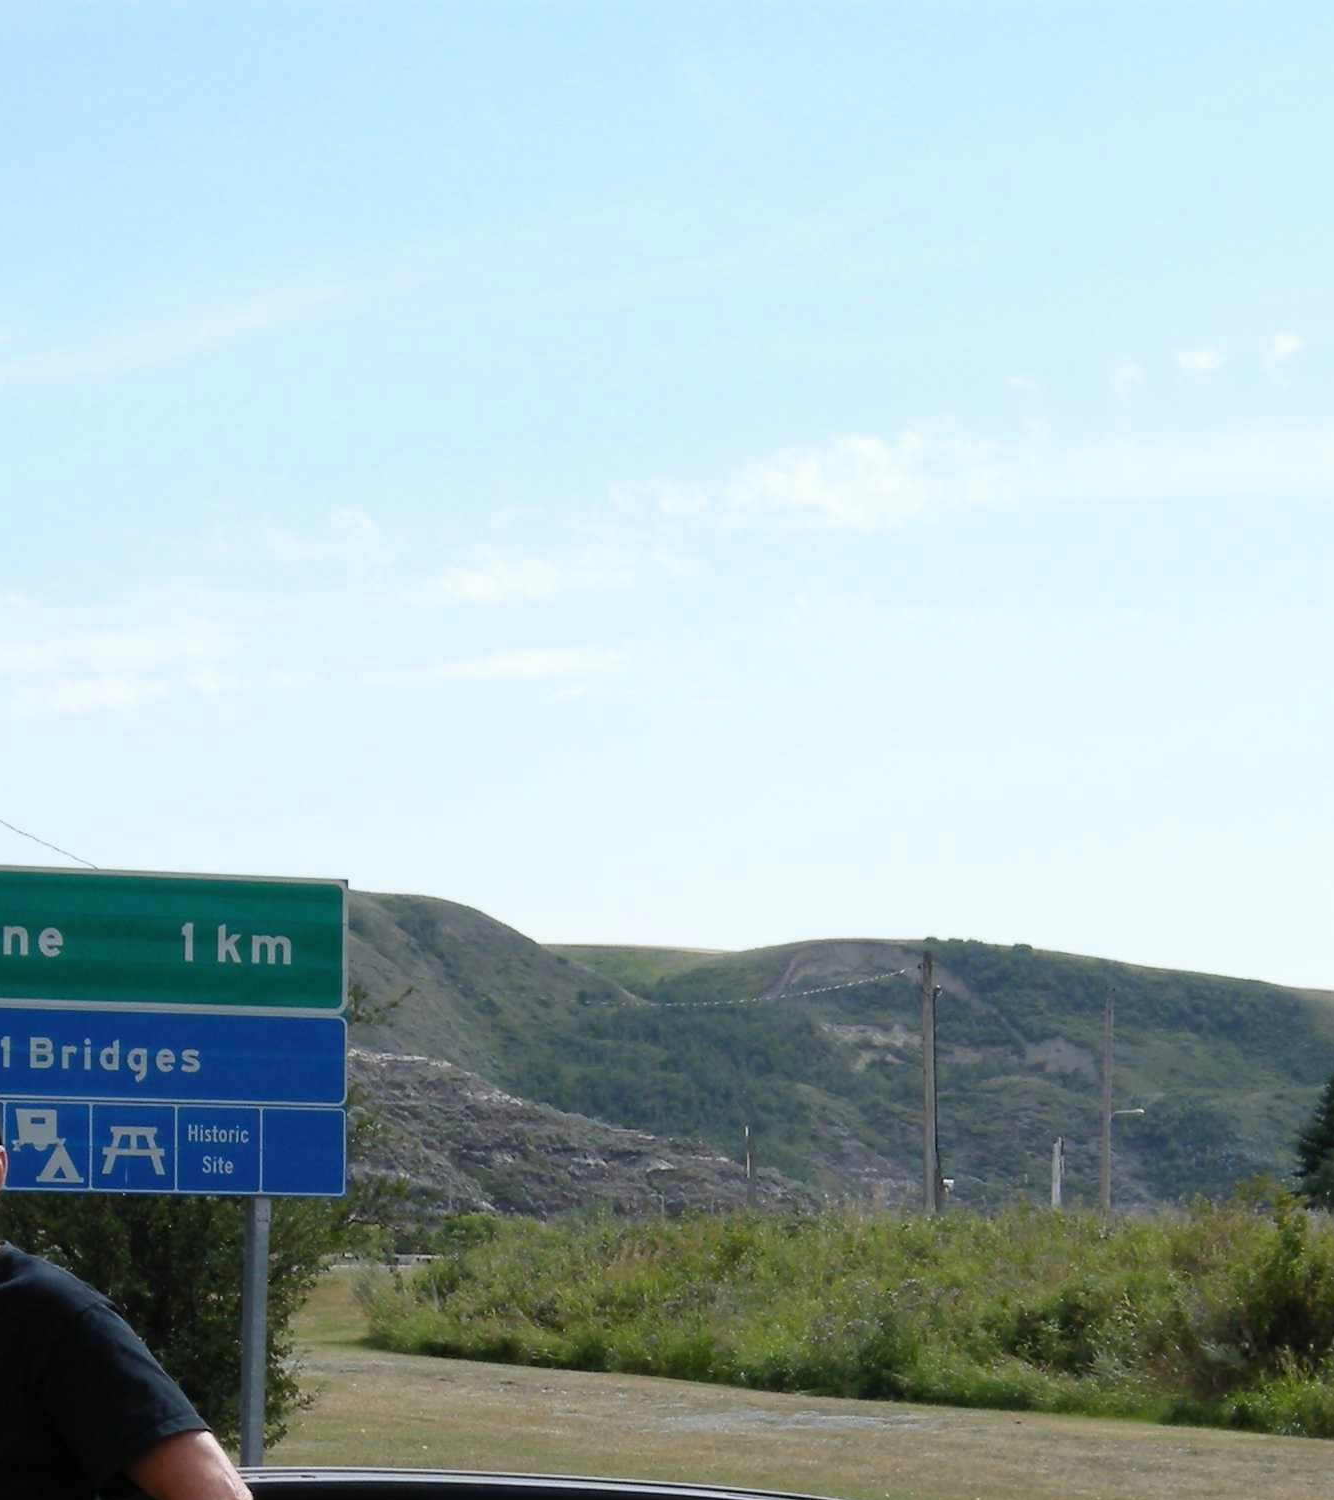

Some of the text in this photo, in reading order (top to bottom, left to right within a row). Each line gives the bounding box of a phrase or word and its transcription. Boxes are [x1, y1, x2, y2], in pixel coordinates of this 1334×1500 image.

[180, 922, 195, 962] 1
[216, 925, 293, 966] km
[30, 1037, 202, 1083] Bridges
[187, 1124, 250, 1145] Historic
[201, 1155, 235, 1176] Site
